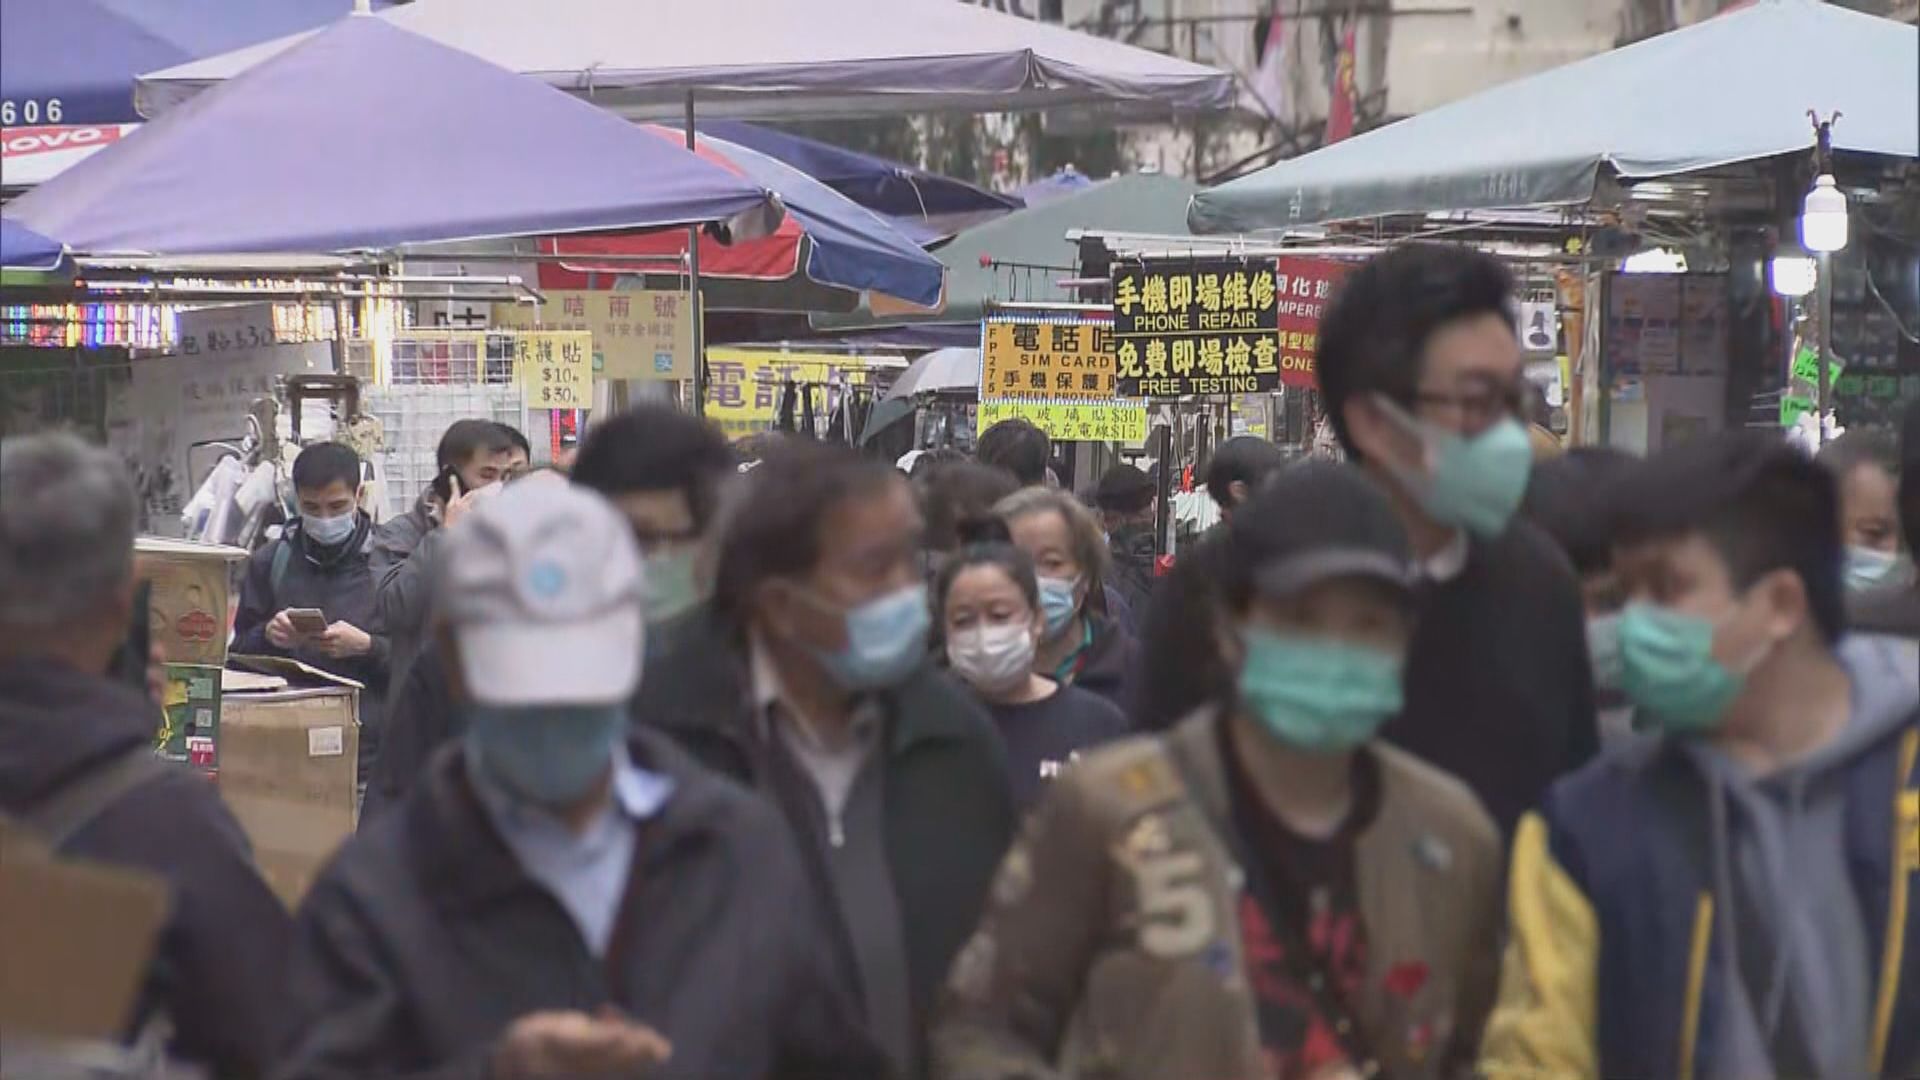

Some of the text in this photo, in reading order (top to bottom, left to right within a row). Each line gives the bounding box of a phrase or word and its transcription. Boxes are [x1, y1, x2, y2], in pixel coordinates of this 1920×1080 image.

[1115, 270, 1276, 316] 手機即場維修
[1134, 311, 1258, 331] PHONE REPAIR
[1020, 354, 1110, 369] SIM CARD
[1117, 334, 1278, 379] 免費即場檢查
[1281, 355, 1314, 371] ONE
[1139, 376, 1258, 395] FREE TESTING
[1138, 851, 1216, 957] 5
